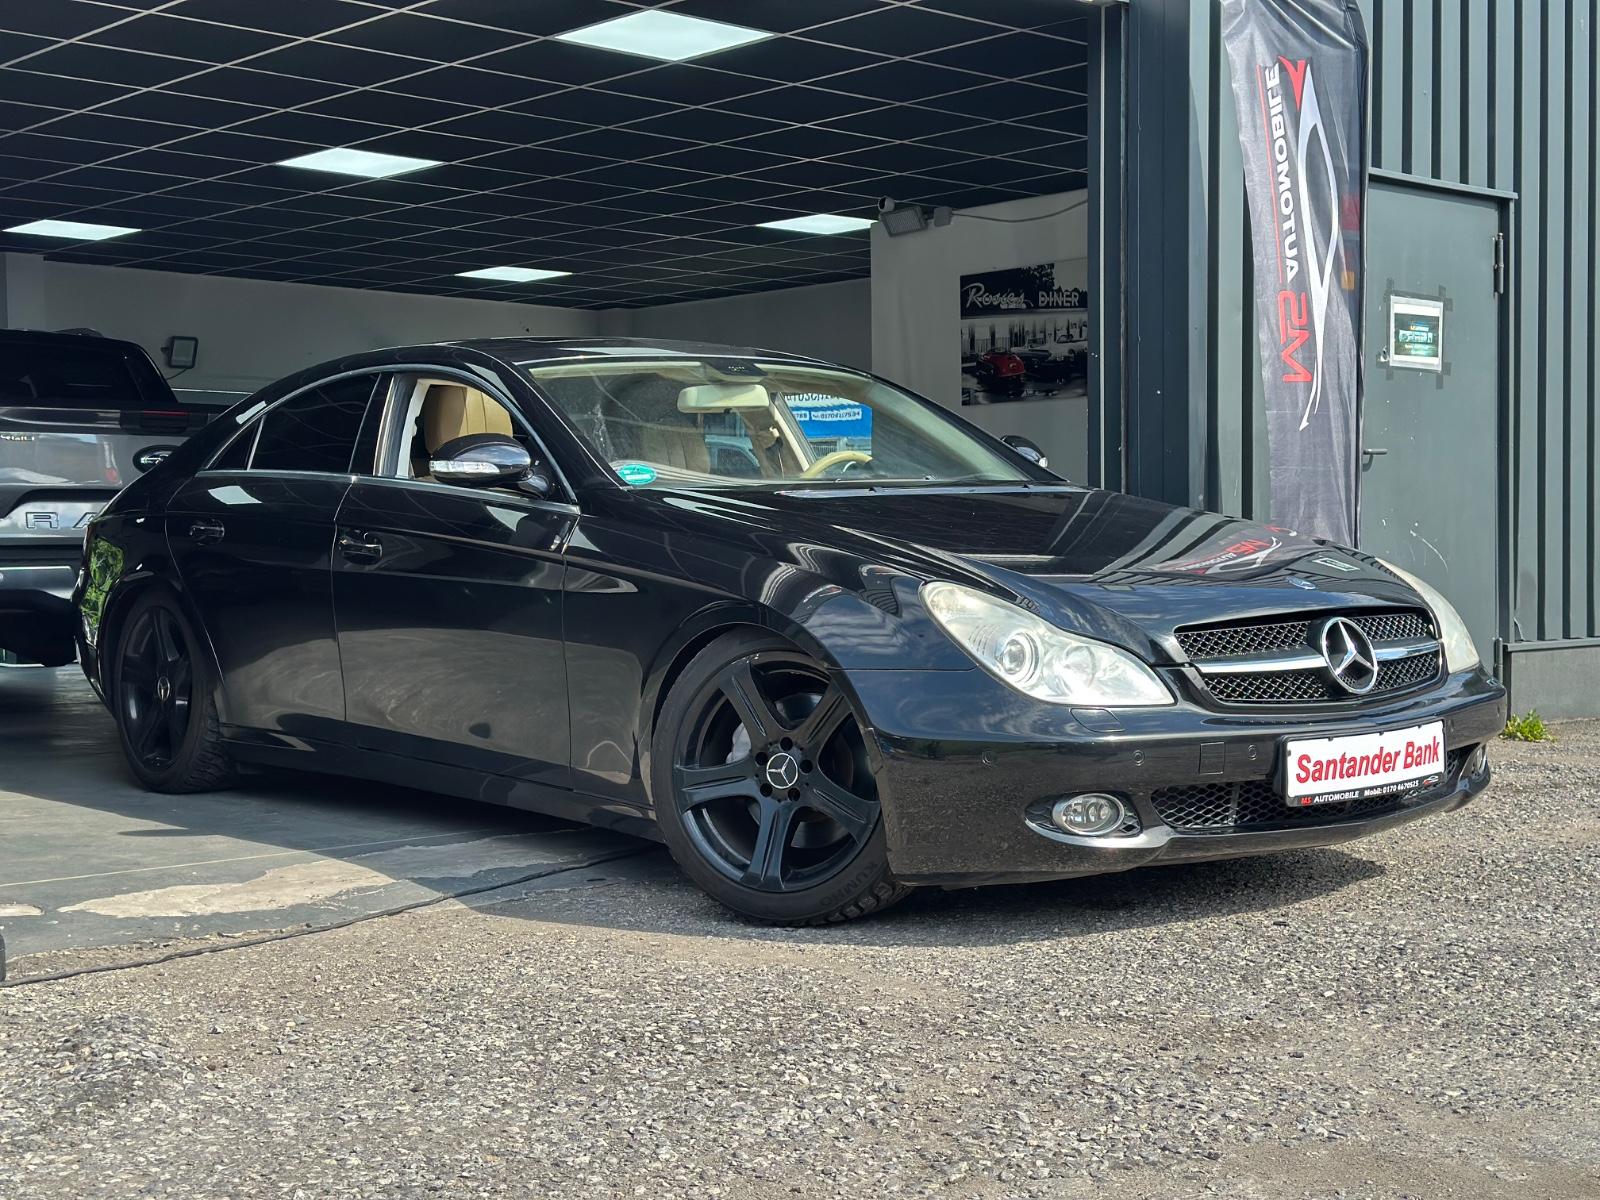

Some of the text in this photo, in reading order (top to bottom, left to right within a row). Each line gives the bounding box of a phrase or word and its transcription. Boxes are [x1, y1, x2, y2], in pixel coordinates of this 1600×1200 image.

[1038, 291, 1080, 307] DINER
[1295, 736, 1440, 784] Santander Bank
[1313, 790, 1360, 804] AUTOMOBILE
